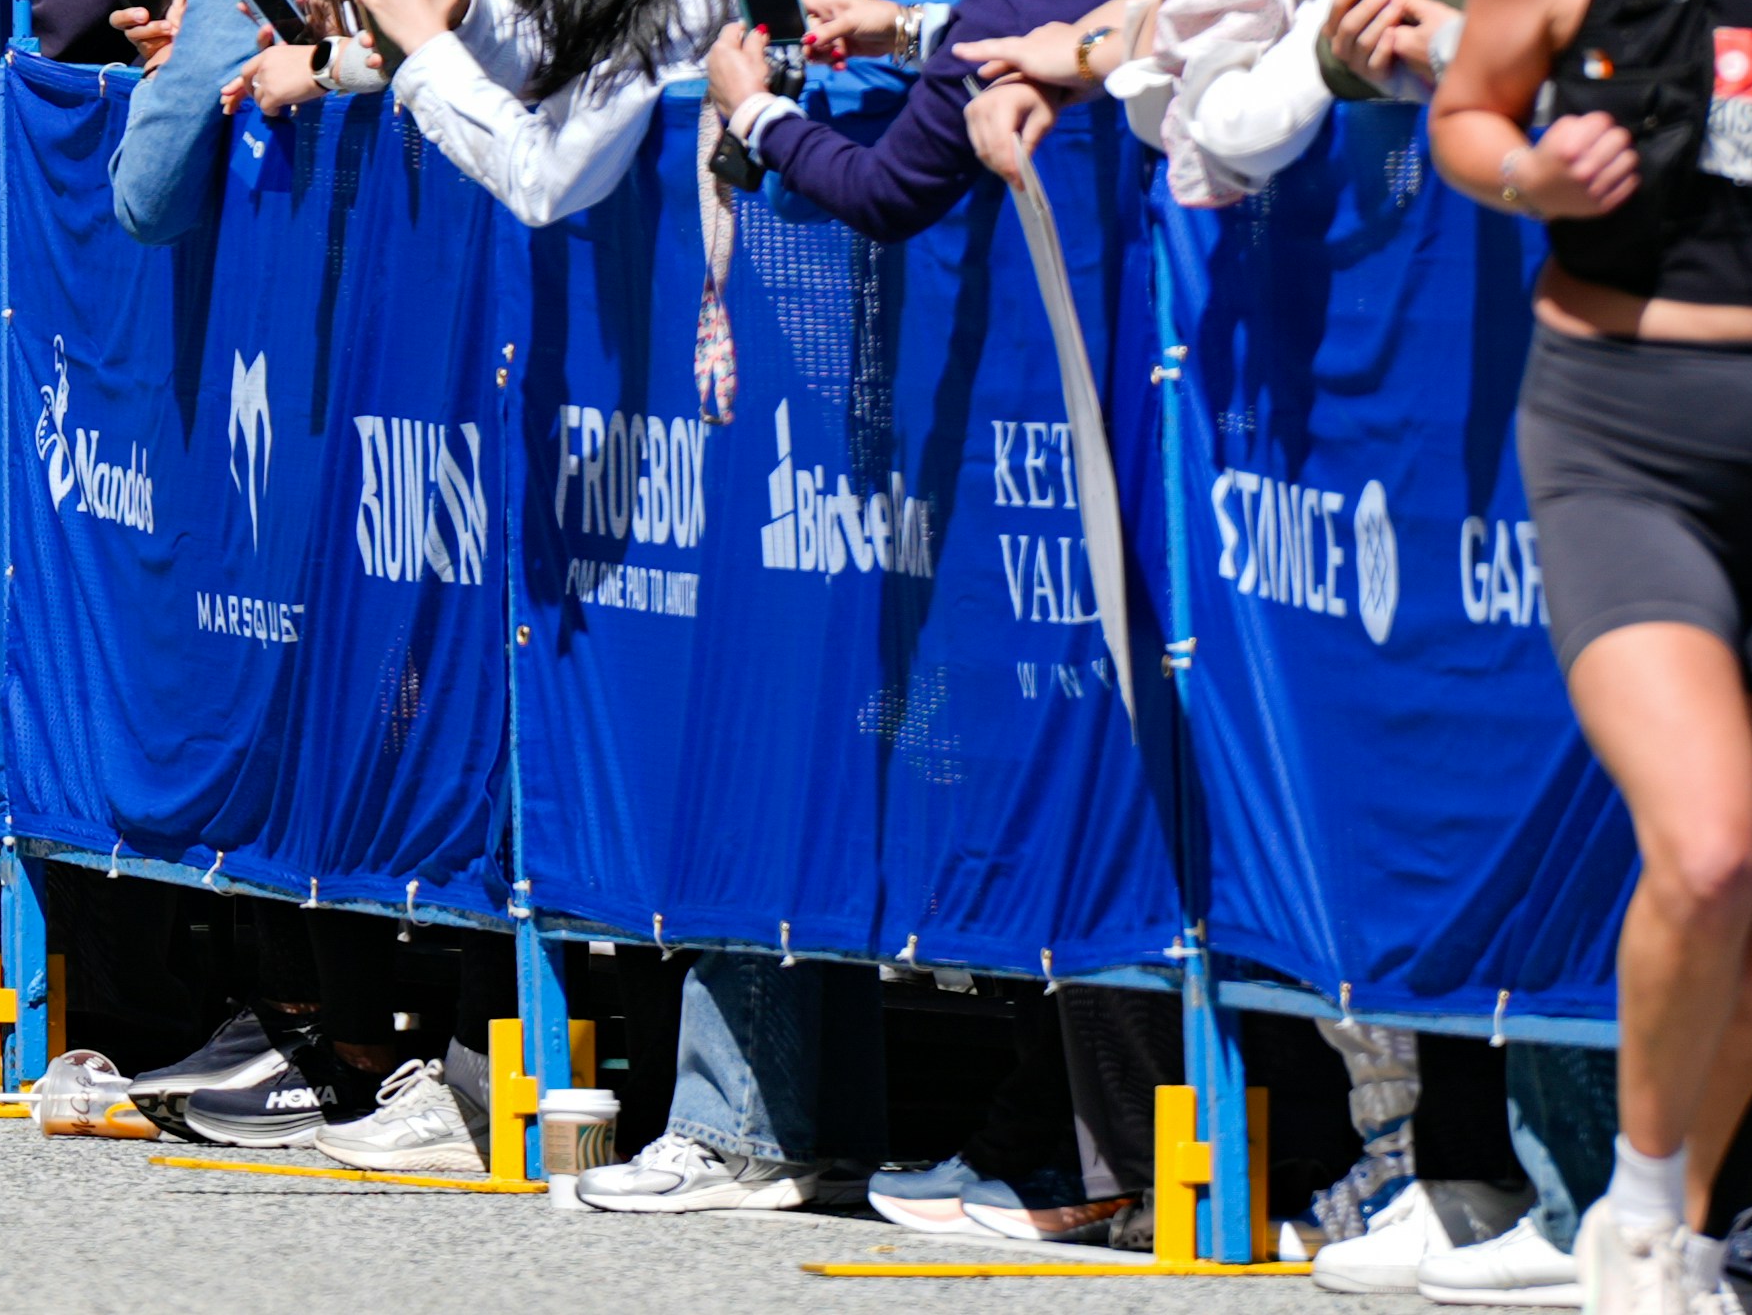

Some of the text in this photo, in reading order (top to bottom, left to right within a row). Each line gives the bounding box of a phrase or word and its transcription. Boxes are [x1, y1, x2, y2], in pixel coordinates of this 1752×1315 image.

[75, 427, 155, 535] Nando's
[554, 404, 707, 549] FROGBOX
[597, 560, 625, 609] ONE
[1210, 466, 1348, 619] STANCE
[265, 1084, 339, 1110] HOKA
